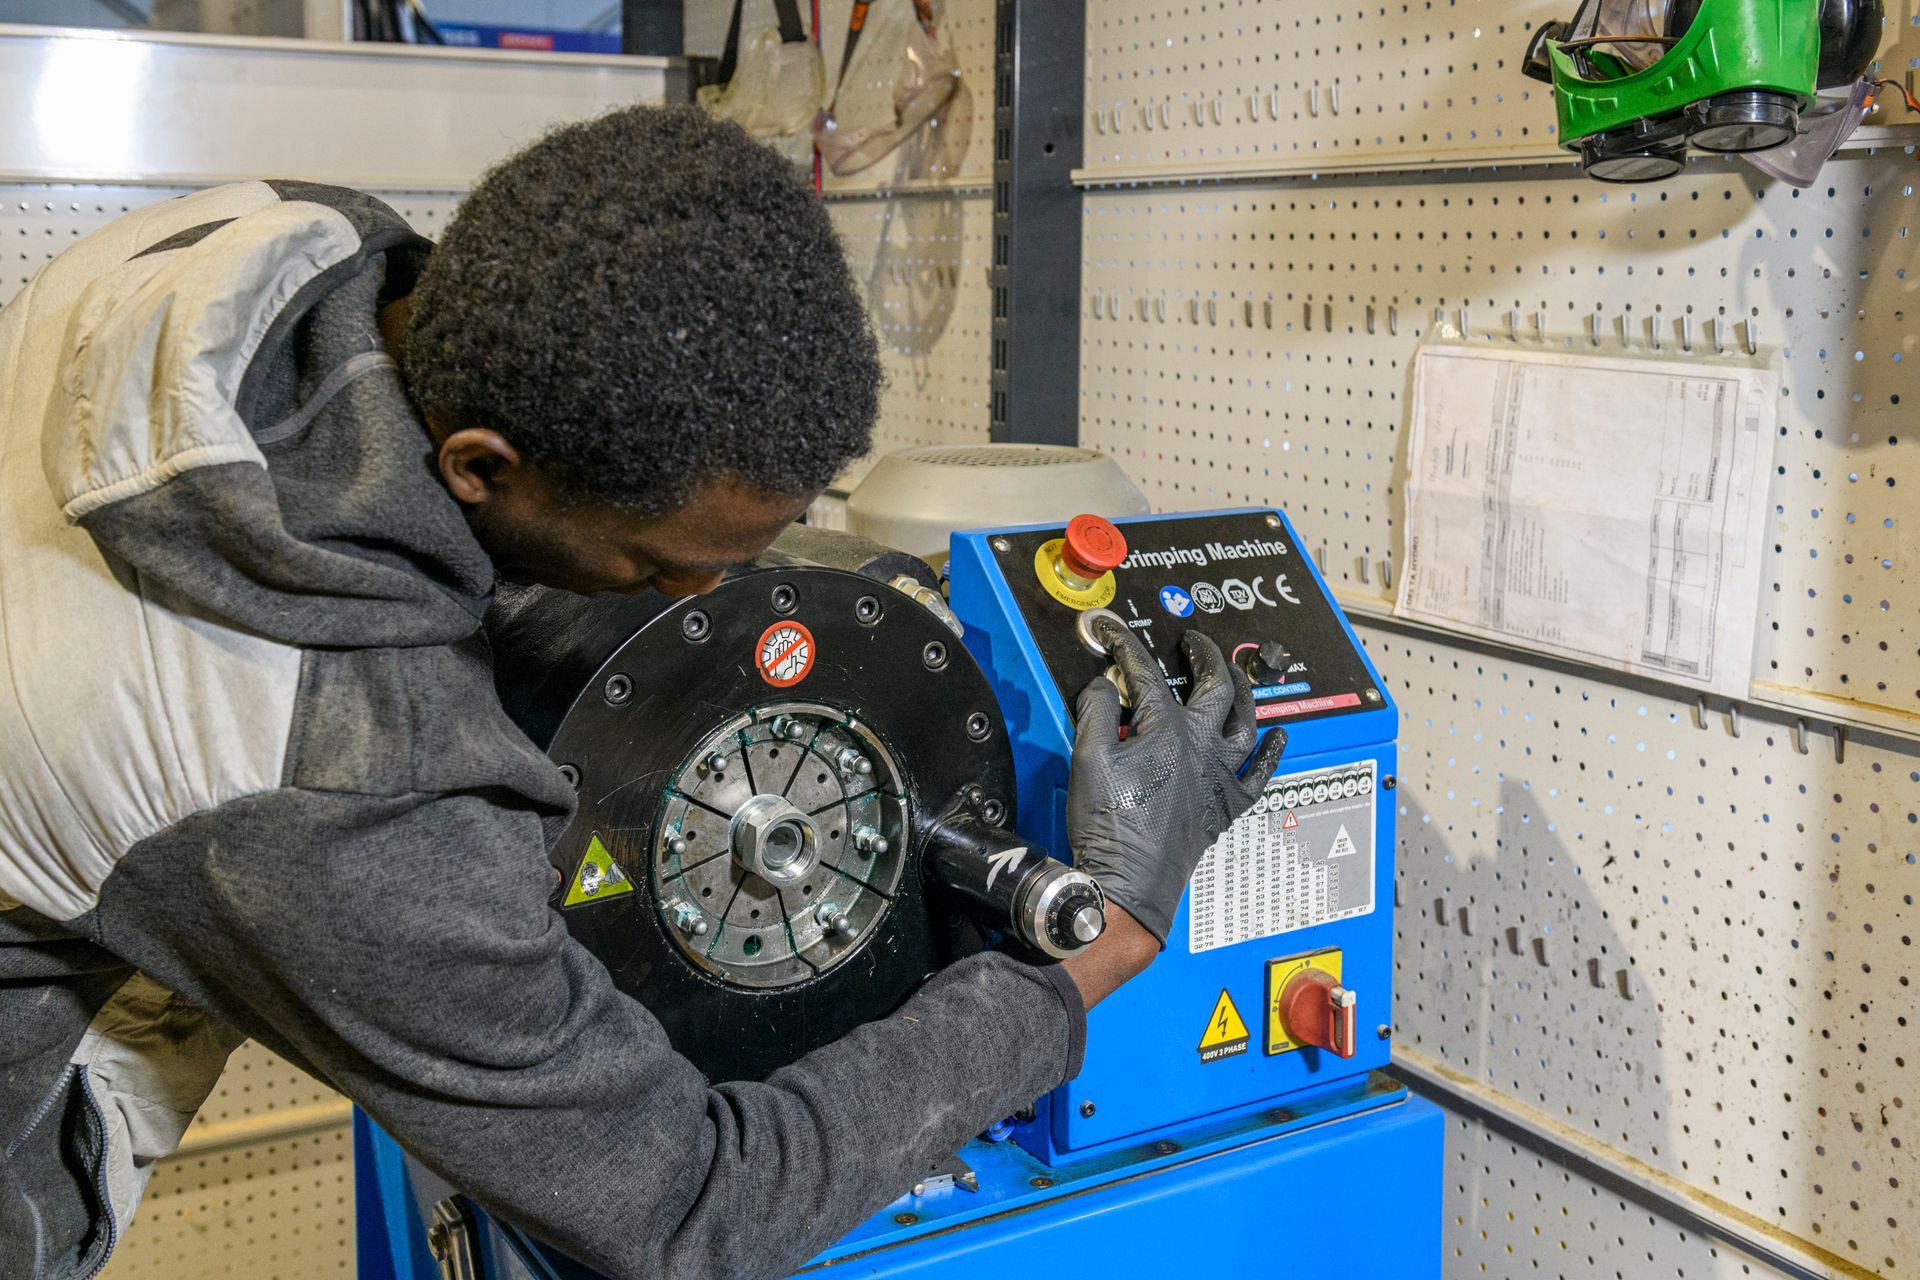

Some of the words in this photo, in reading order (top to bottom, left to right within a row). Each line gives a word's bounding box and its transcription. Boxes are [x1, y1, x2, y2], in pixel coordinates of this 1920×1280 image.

[1205, 538, 1288, 561] Machine
[1055, 590, 1100, 608] EMERGENCY
[1128, 618, 1153, 628] CRIMP
[1252, 688, 1272, 698] RACT
[1272, 684, 1309, 695] CONTROL
[1259, 703, 1300, 715] Crimping
[1299, 698, 1335, 710] Machine
[1194, 868, 1215, 877] 32-26
[1194, 876, 1215, 884] 32-30
[1194, 883, 1214, 891] 32-34
[1194, 890, 1214, 899] 32-39
[1194, 897, 1214, 906] 32-45
[1194, 905, 1214, 913] 32-51
[1194, 912, 1214, 920] 32-57
[1194, 919, 1214, 928] 32-63
[1194, 926, 1214, 935] 32-69
[1194, 934, 1213, 942] 32-74
[1194, 941, 1214, 950] 32-78
[1202, 1050, 1218, 1060] 400V
[1223, 1042, 1247, 1055] PHASE
